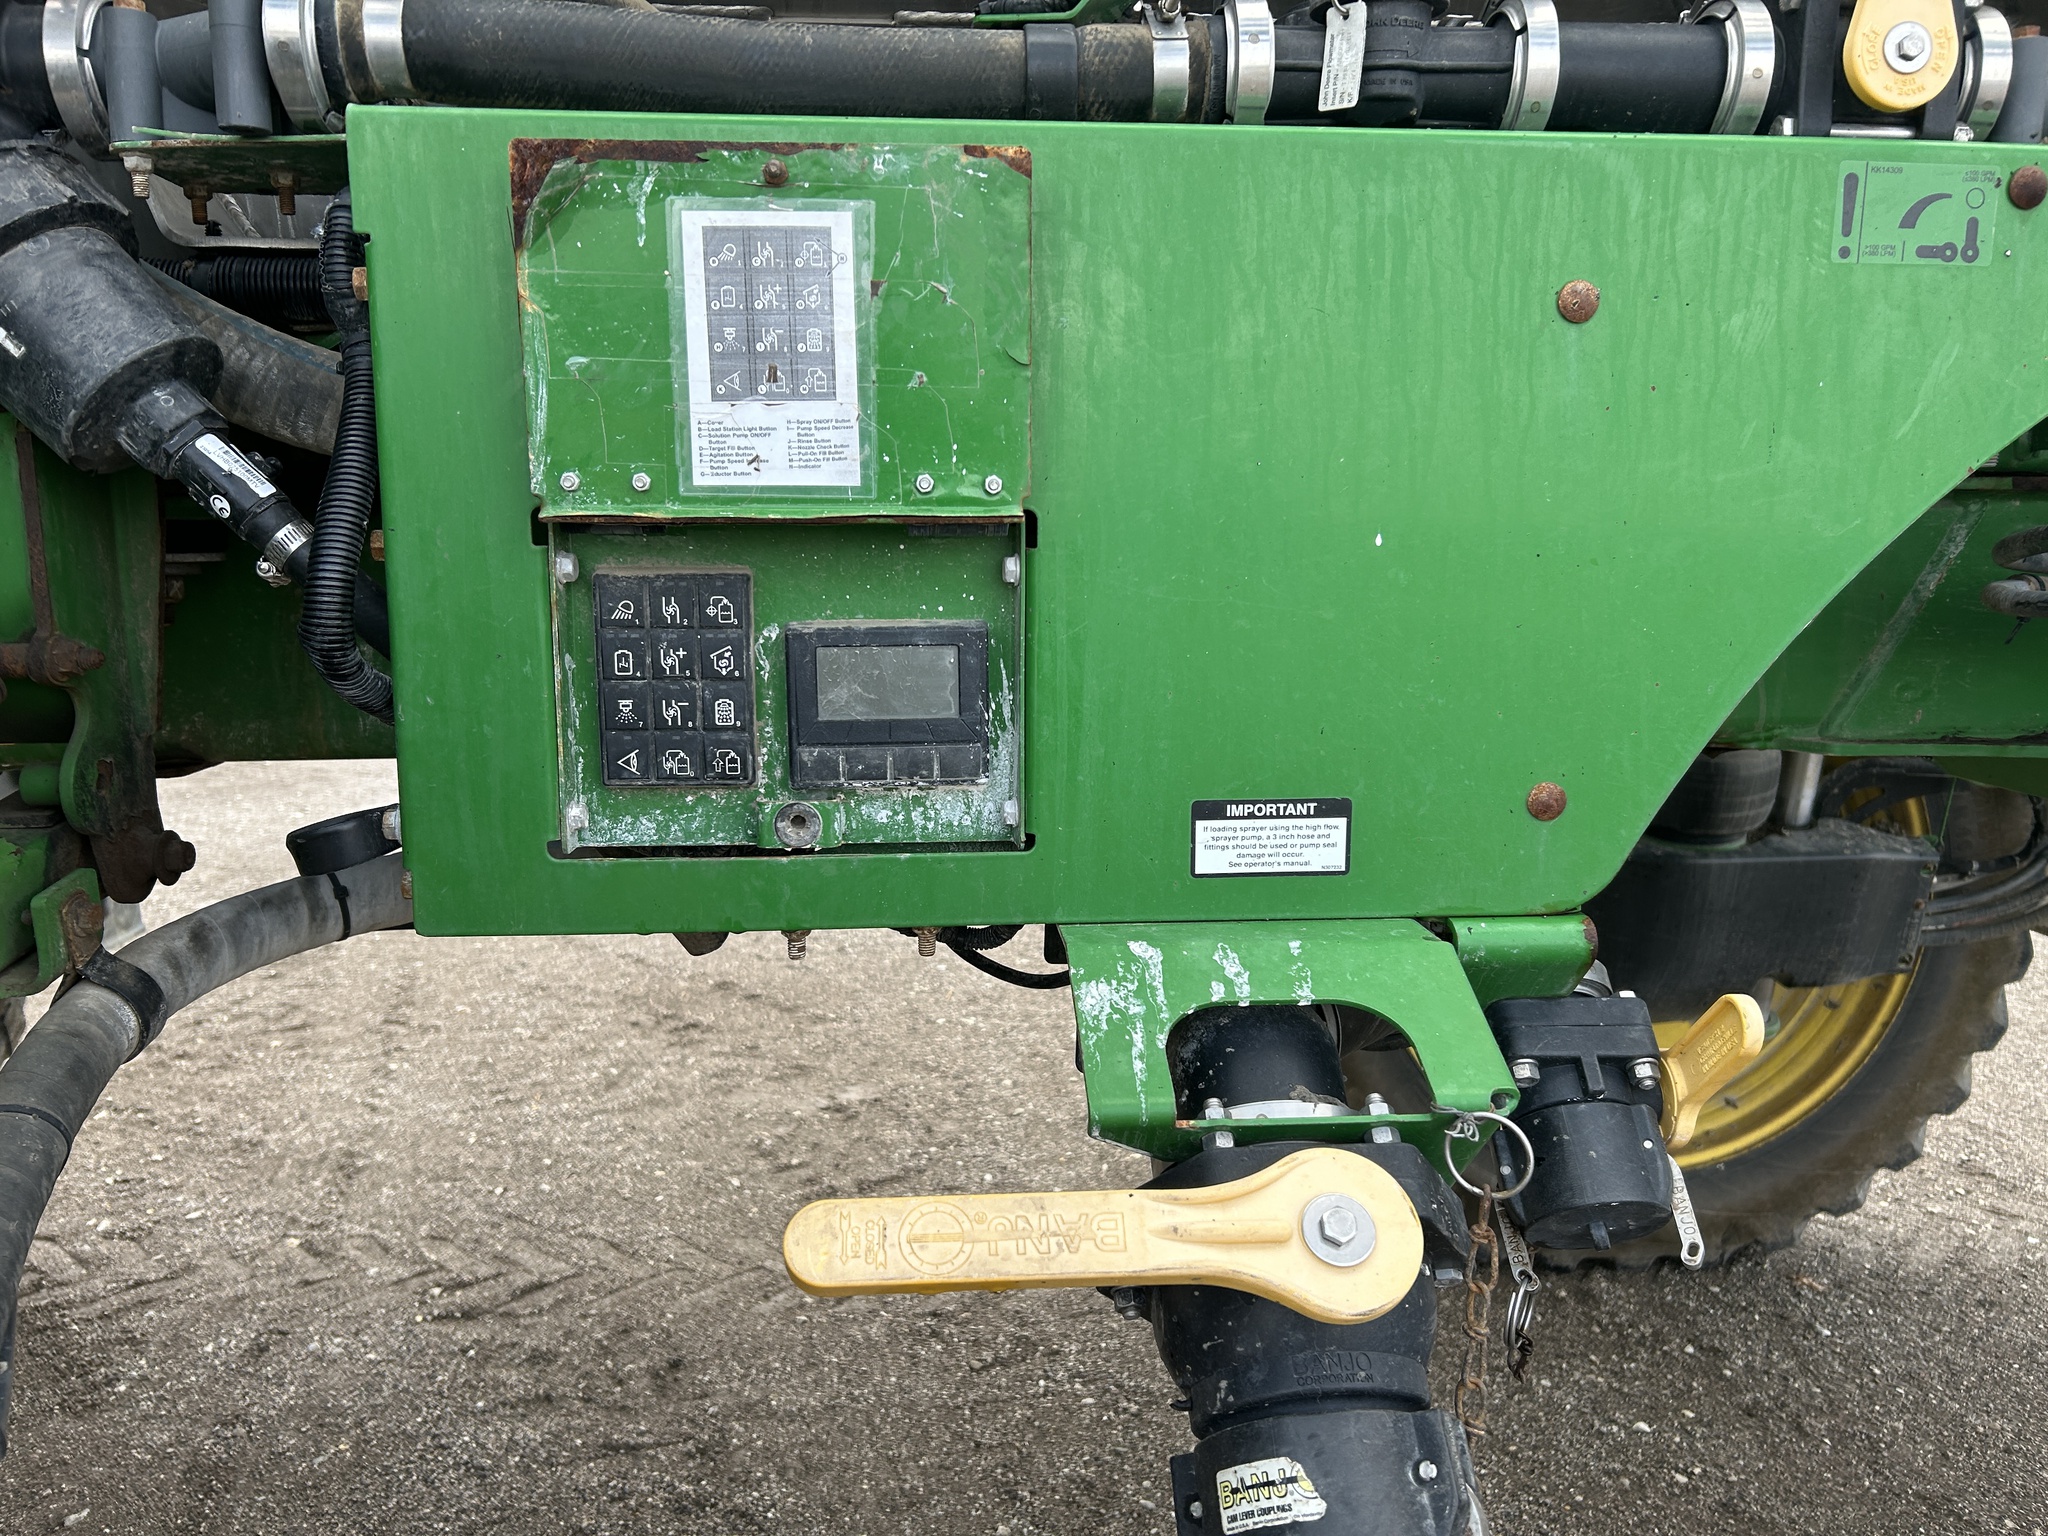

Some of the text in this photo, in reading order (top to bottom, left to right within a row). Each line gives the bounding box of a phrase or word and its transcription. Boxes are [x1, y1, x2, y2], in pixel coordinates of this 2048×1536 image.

[1391, 16, 1425, 30] DEERE
[1327, 33, 1335, 68] Flowmeter
[1324, 69, 1332, 89] Deere
[1870, 166, 1903, 174] KK14309
[1226, 803, 1317, 817] IMPORTANT
[1210, 825, 1237, 833] loading
[1305, 824, 1321, 832] high
[1300, 842, 1320, 850] pump
[1236, 852, 1265, 860] damage
[1244, 861, 1281, 869] operator's
[1672, 1185, 1696, 1235] BANJO
[851, 1226, 861, 1258] OPEN
[865, 1219, 875, 1265] CLOSED
[1290, 1350, 1373, 1378] BANJO
[1227, 1515, 1238, 1524] CAM
[1240, 1510, 1255, 1521] LEVER
[1257, 1503, 1292, 1517] COUPLINGS
